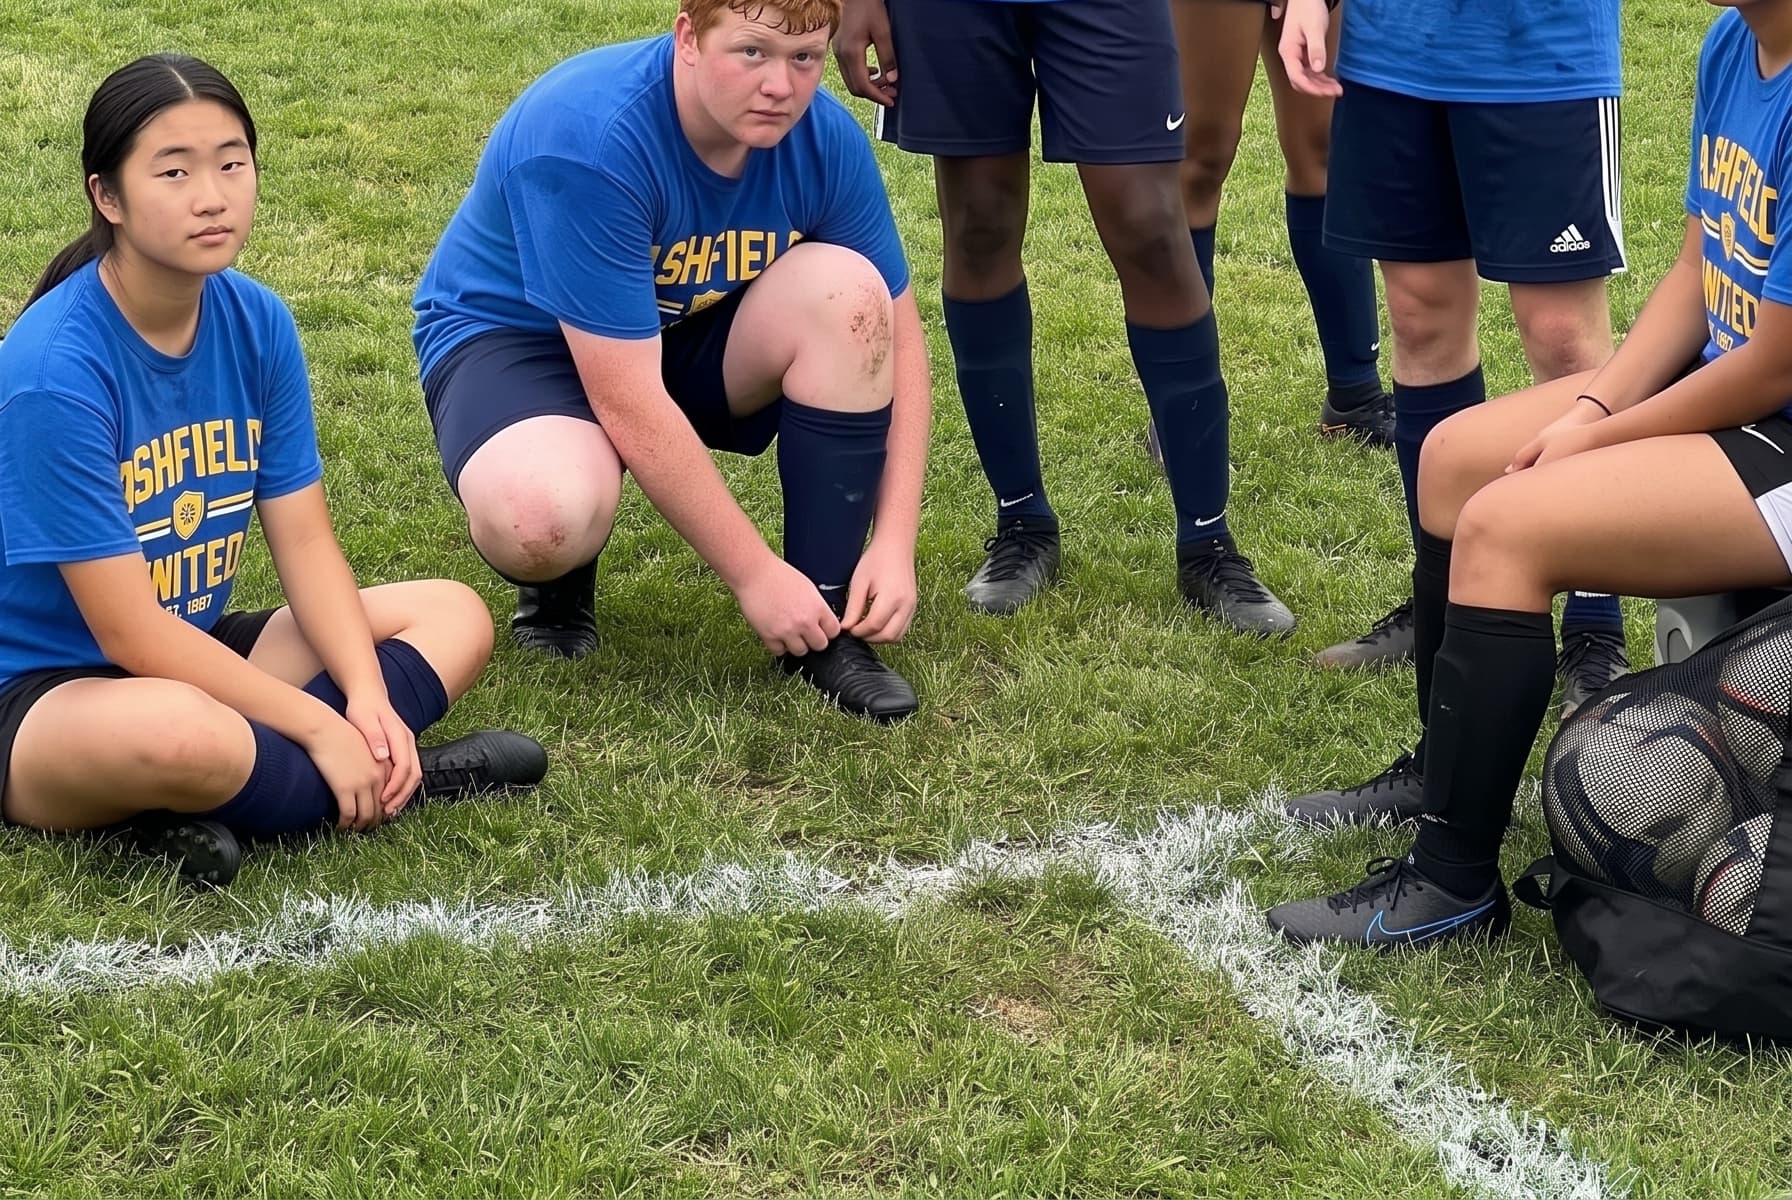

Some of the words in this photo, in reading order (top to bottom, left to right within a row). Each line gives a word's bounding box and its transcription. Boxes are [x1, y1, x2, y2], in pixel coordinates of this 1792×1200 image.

[651, 230, 805, 285] SHFIEL
[1549, 240, 1591, 253] adidas
[1702, 255, 1759, 338] NITED
[147, 531, 245, 602] NITED
[187, 592, 213, 615] 1887
